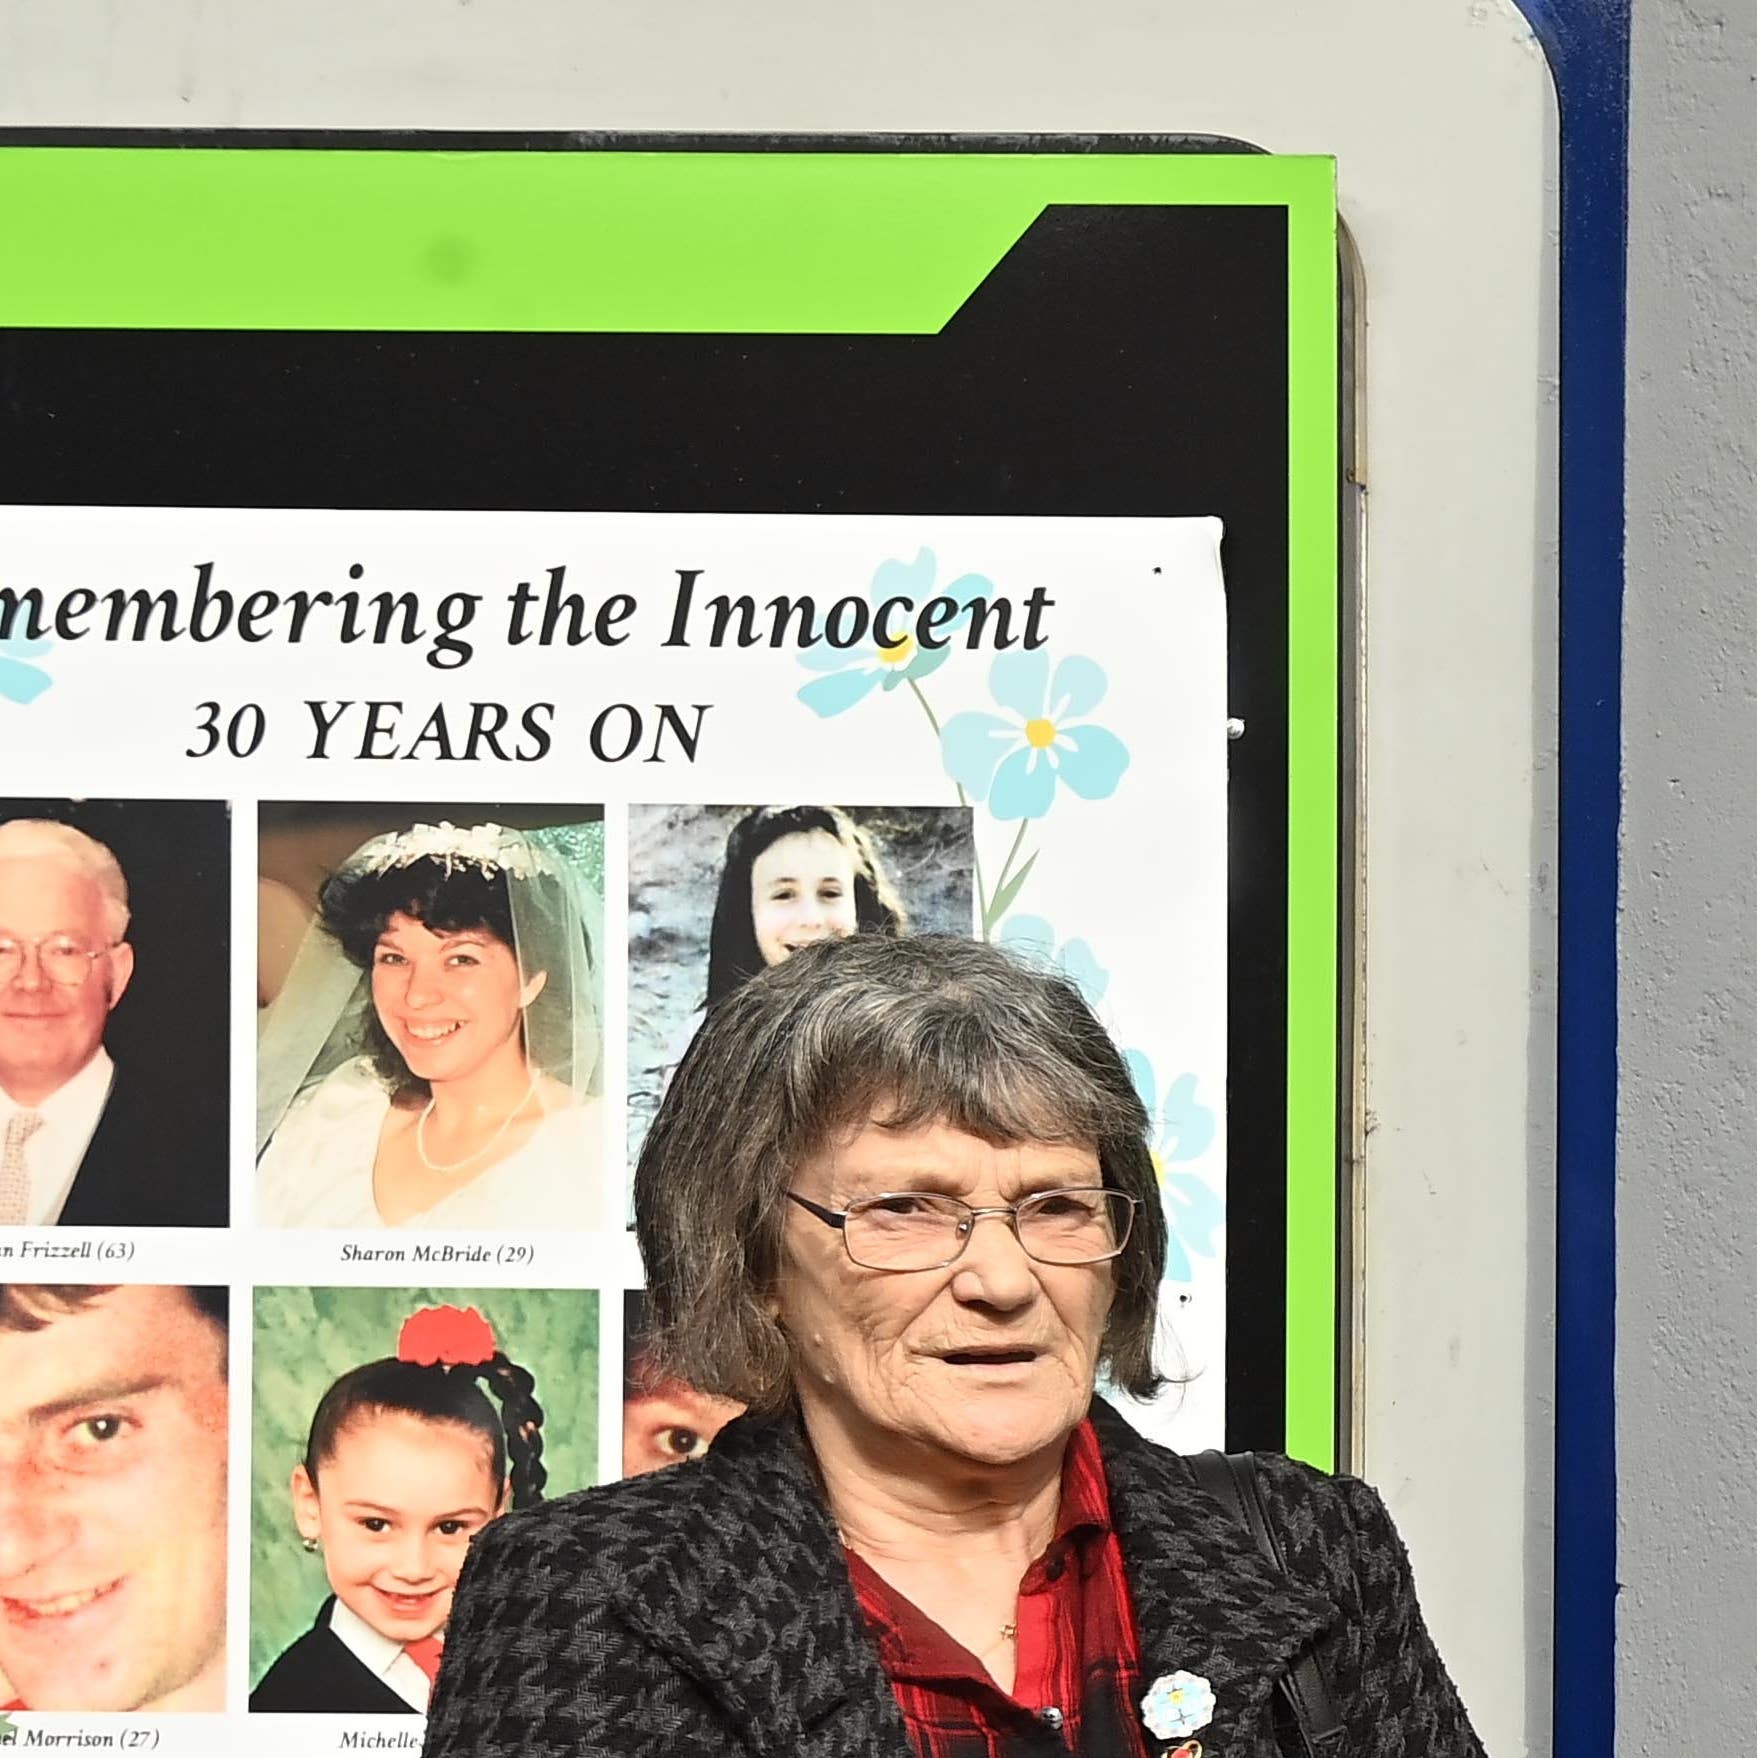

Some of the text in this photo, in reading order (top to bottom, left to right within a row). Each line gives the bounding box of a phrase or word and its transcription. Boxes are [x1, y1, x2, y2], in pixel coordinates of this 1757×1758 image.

[507, 565, 637, 648] the
[660, 569, 1056, 652] Innocent
[185, 701, 713, 764] 30 YEARS ON
[20, 1240, 92, 1258] Frizzell
[97, 1241, 135, 1262] (63)
[340, 1243, 536, 1265] Sharon McBride (29)
[24, 1728, 114, 1748] Morrison
[119, 1728, 161, 1750] (27)
[338, 1731, 419, 1750] Michelle
